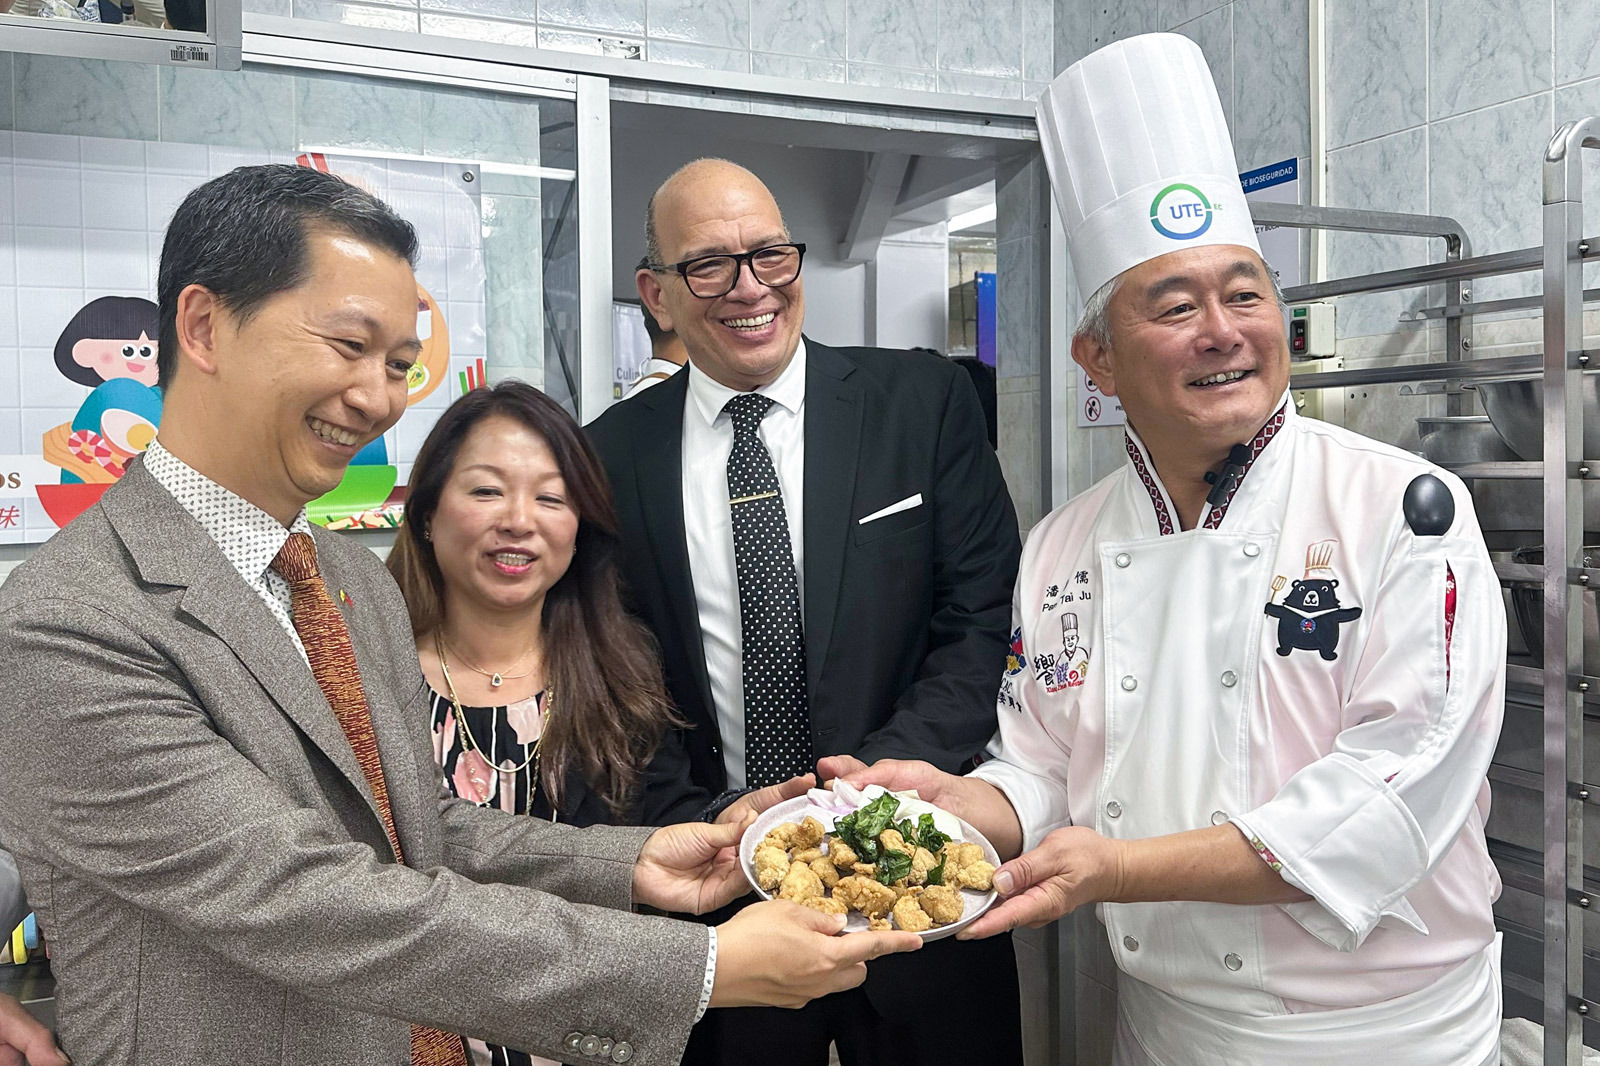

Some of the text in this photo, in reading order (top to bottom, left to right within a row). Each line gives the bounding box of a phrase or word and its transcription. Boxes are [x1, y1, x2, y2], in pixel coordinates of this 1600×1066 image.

[1249, 166, 1293, 186] BIOSEGURIDAD
[1169, 203, 1223, 220] UTE EC
[1079, 590, 1091, 601] Ju
